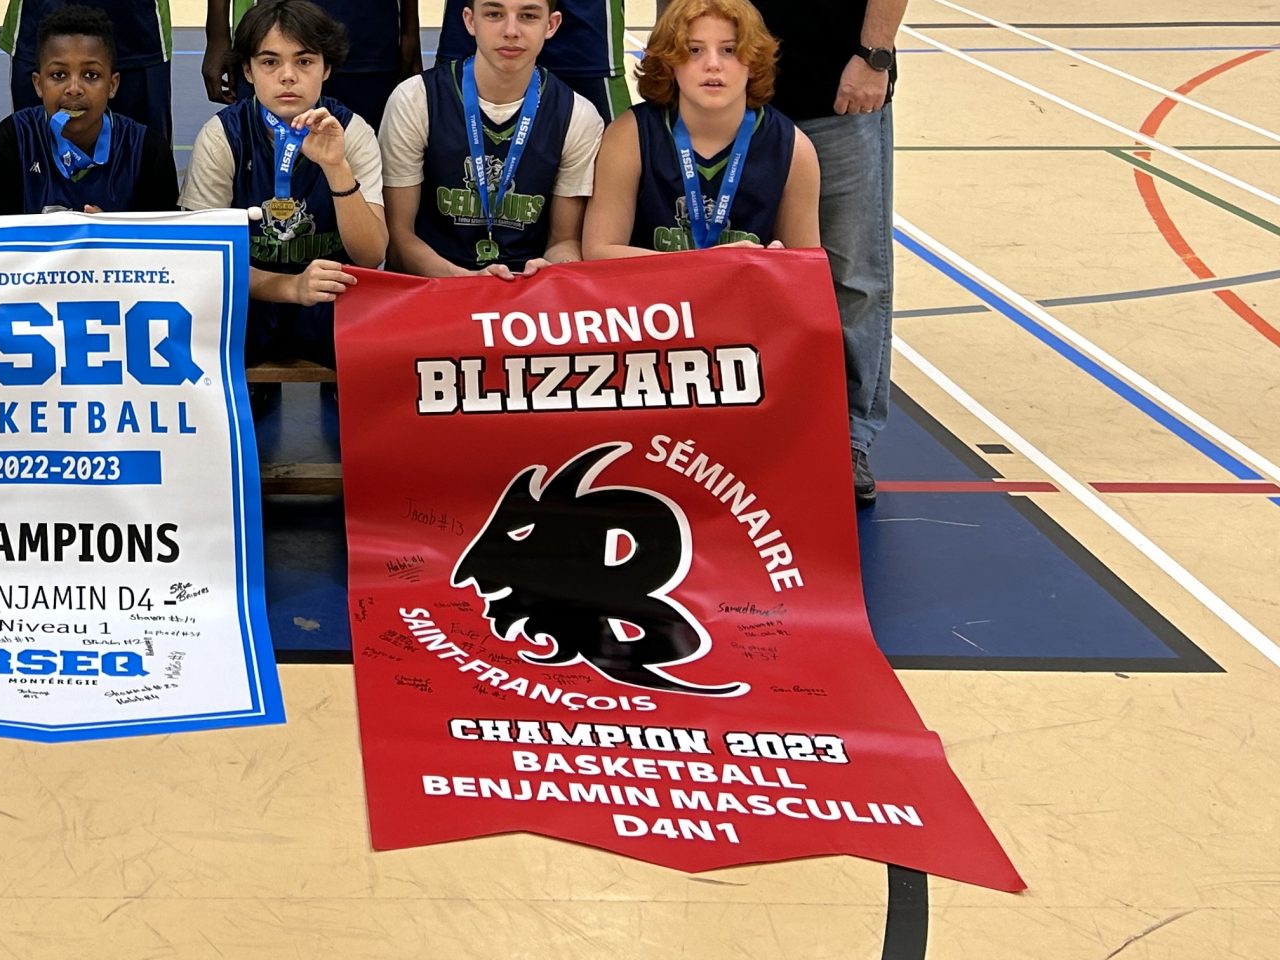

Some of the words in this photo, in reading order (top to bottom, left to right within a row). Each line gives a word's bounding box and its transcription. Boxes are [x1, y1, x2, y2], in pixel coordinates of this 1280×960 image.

[516, 116, 530, 145] RSEQ
[280, 143, 296, 173] RSEQ
[475, 156, 485, 186] RSEQ
[681, 149, 695, 179] RSEQ
[715, 195, 730, 224] RSEQ
[102, 267, 176, 286] FIERTÉ.
[471, 300, 694, 348] TOURNOI
[417, 346, 763, 415] BLIZZARD
[646, 434, 804, 592] SÉMINAIRE
[119, 585, 154, 611] D4
[99, 622, 111, 634] 1
[399, 607, 658, 712] SAINT-FRANÇOIS
[9, 677, 98, 685] MONTÉRÉGIE
[449, 718, 712, 756] CHAMPION
[726, 733, 851, 765] 2023
[511, 750, 807, 790] BASKETBALL
[422, 775, 662, 811] BENJAMIN
[672, 790, 924, 827] MASCULIN
[612, 813, 741, 844] D4N1
